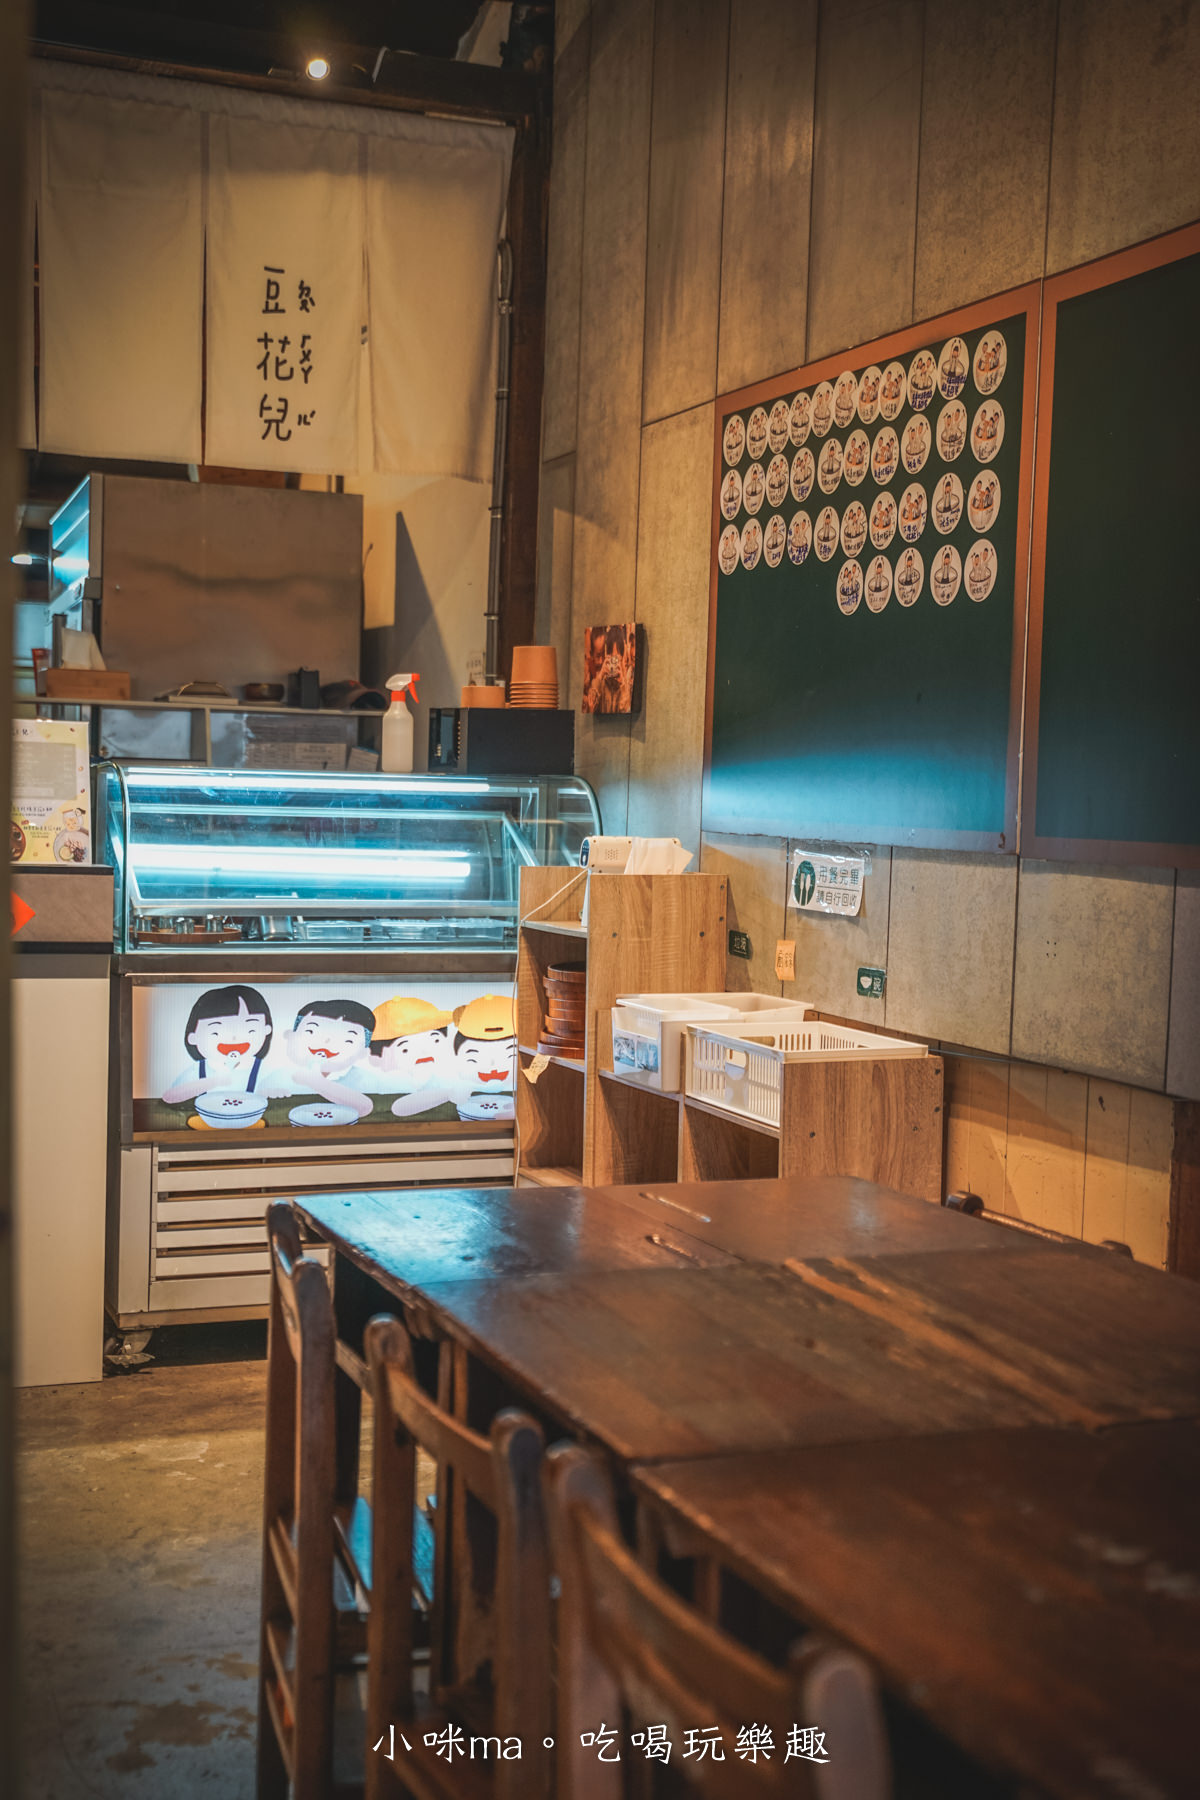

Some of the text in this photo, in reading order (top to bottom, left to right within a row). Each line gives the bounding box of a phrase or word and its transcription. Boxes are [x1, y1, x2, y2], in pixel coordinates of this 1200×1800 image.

[257, 266, 294, 441] 豆花兒
[819, 866, 859, 886] 用餐完畢
[816, 889, 858, 907] 請自行回收
